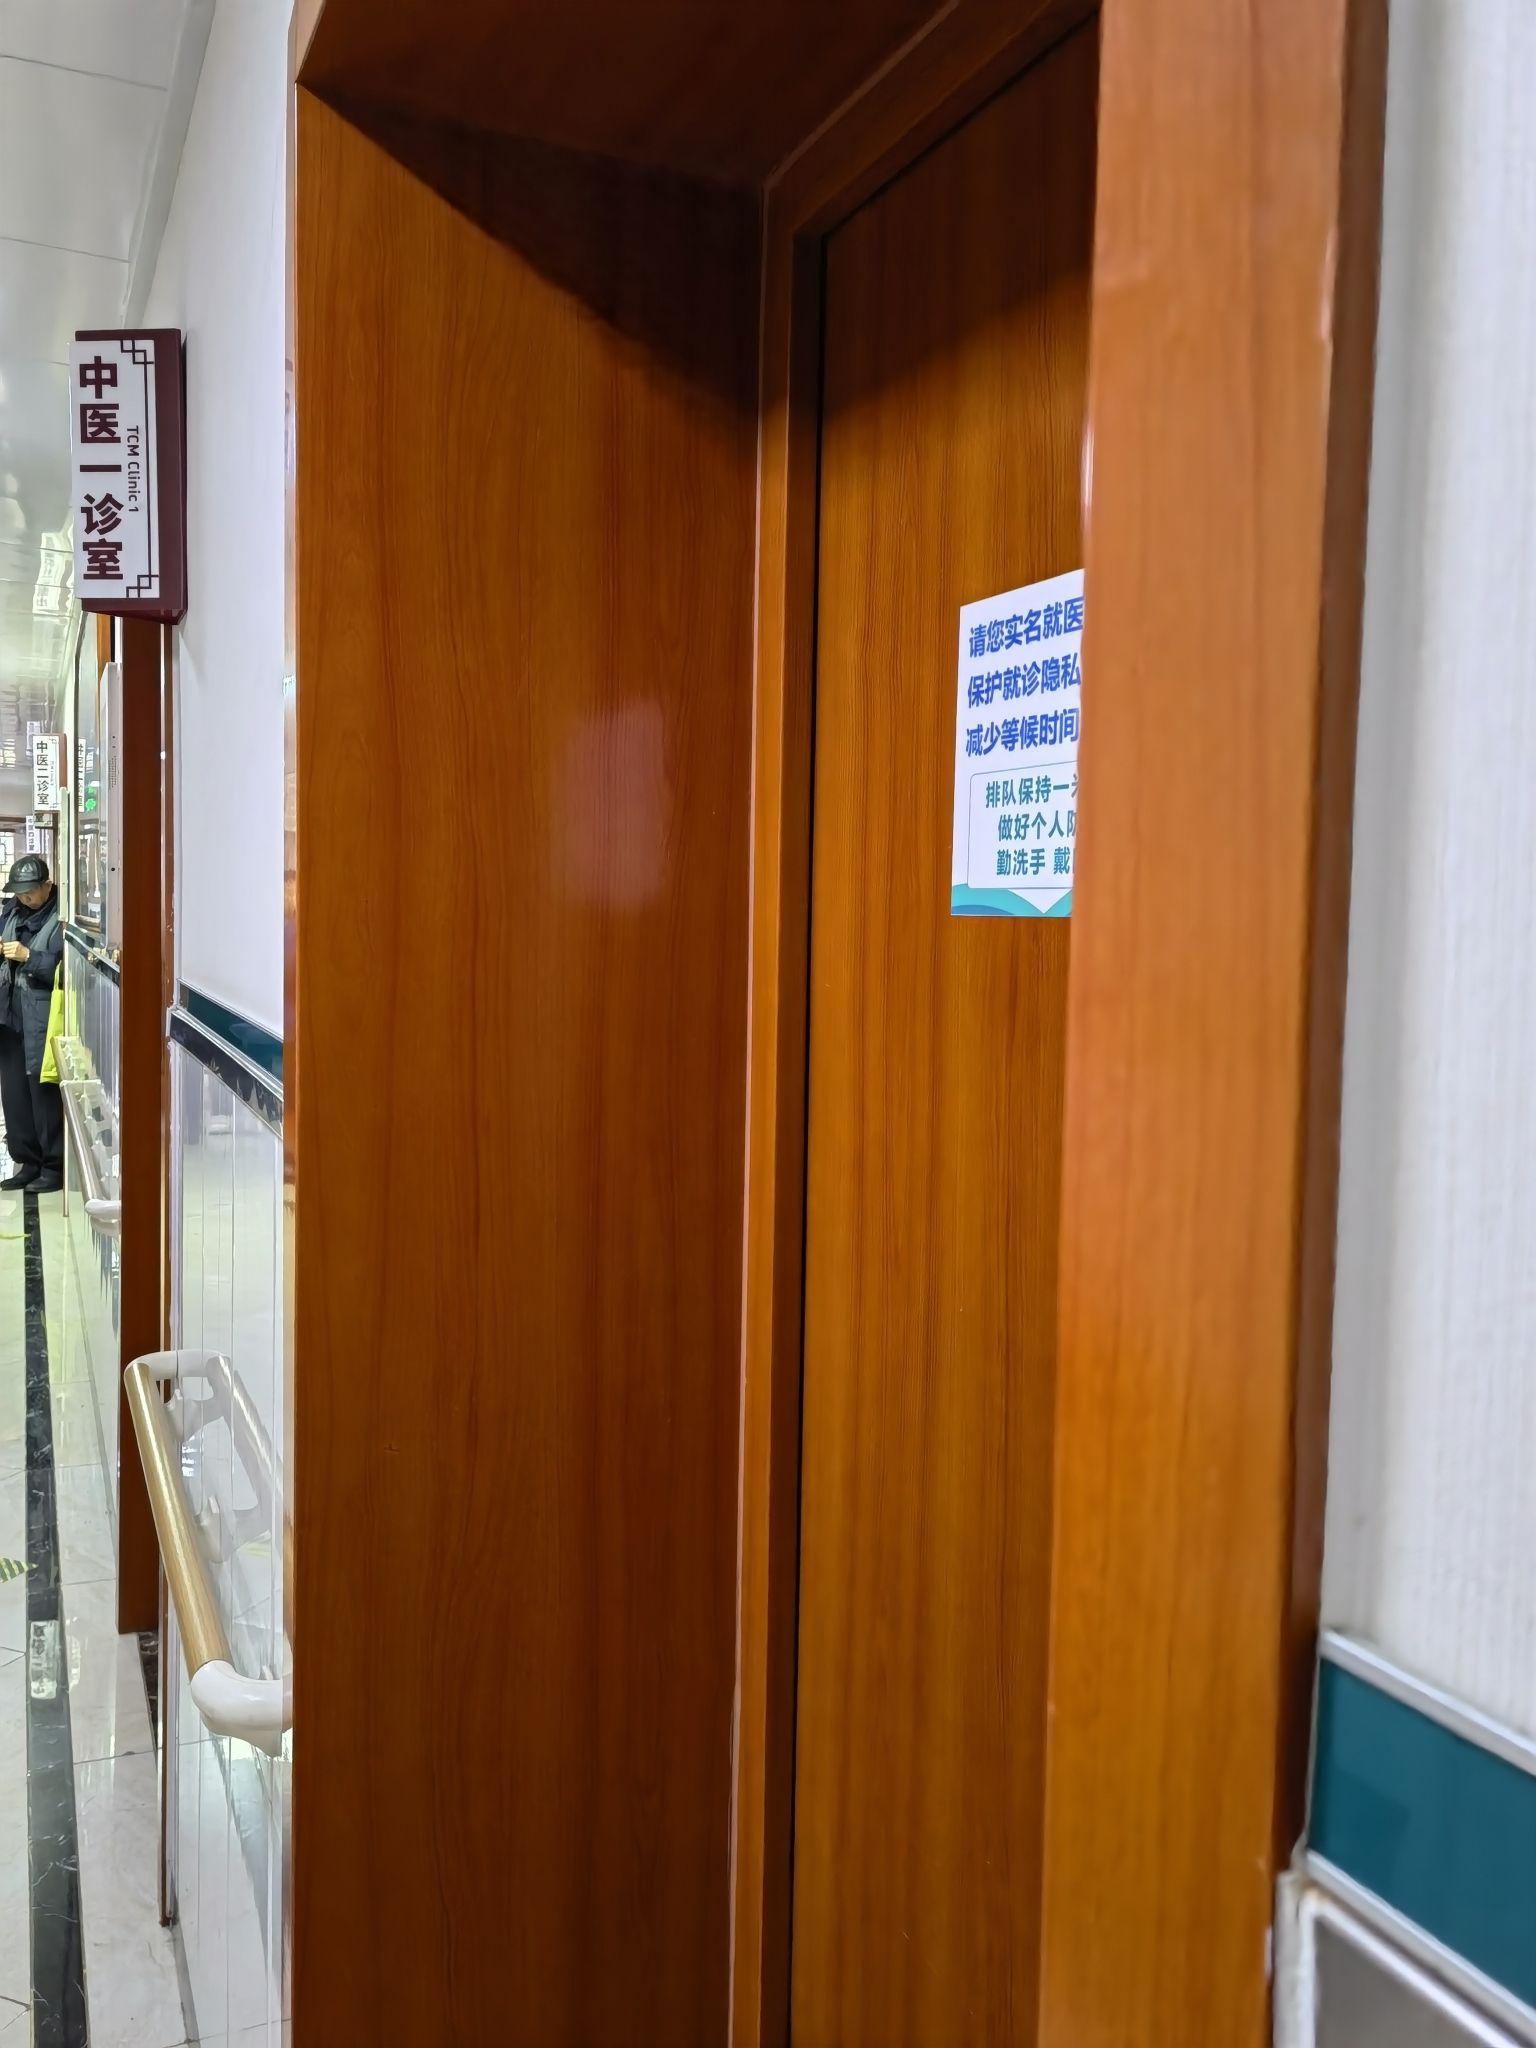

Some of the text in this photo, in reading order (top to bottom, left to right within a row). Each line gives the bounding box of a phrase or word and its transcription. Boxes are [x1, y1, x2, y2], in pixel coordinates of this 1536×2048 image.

[79, 355, 125, 580] 中医一诊室
[126, 425, 140, 457] TCM
[127, 462, 141, 502] Clinic
[968, 596, 1084, 658] 请您实名就医
[967, 652, 1082, 709] 保护就诊隐私
[965, 707, 1080, 757] 减少等候时间
[36, 740, 50, 806] 中医二诊室
[996, 846, 1077, 876] 勤洗手 戴
